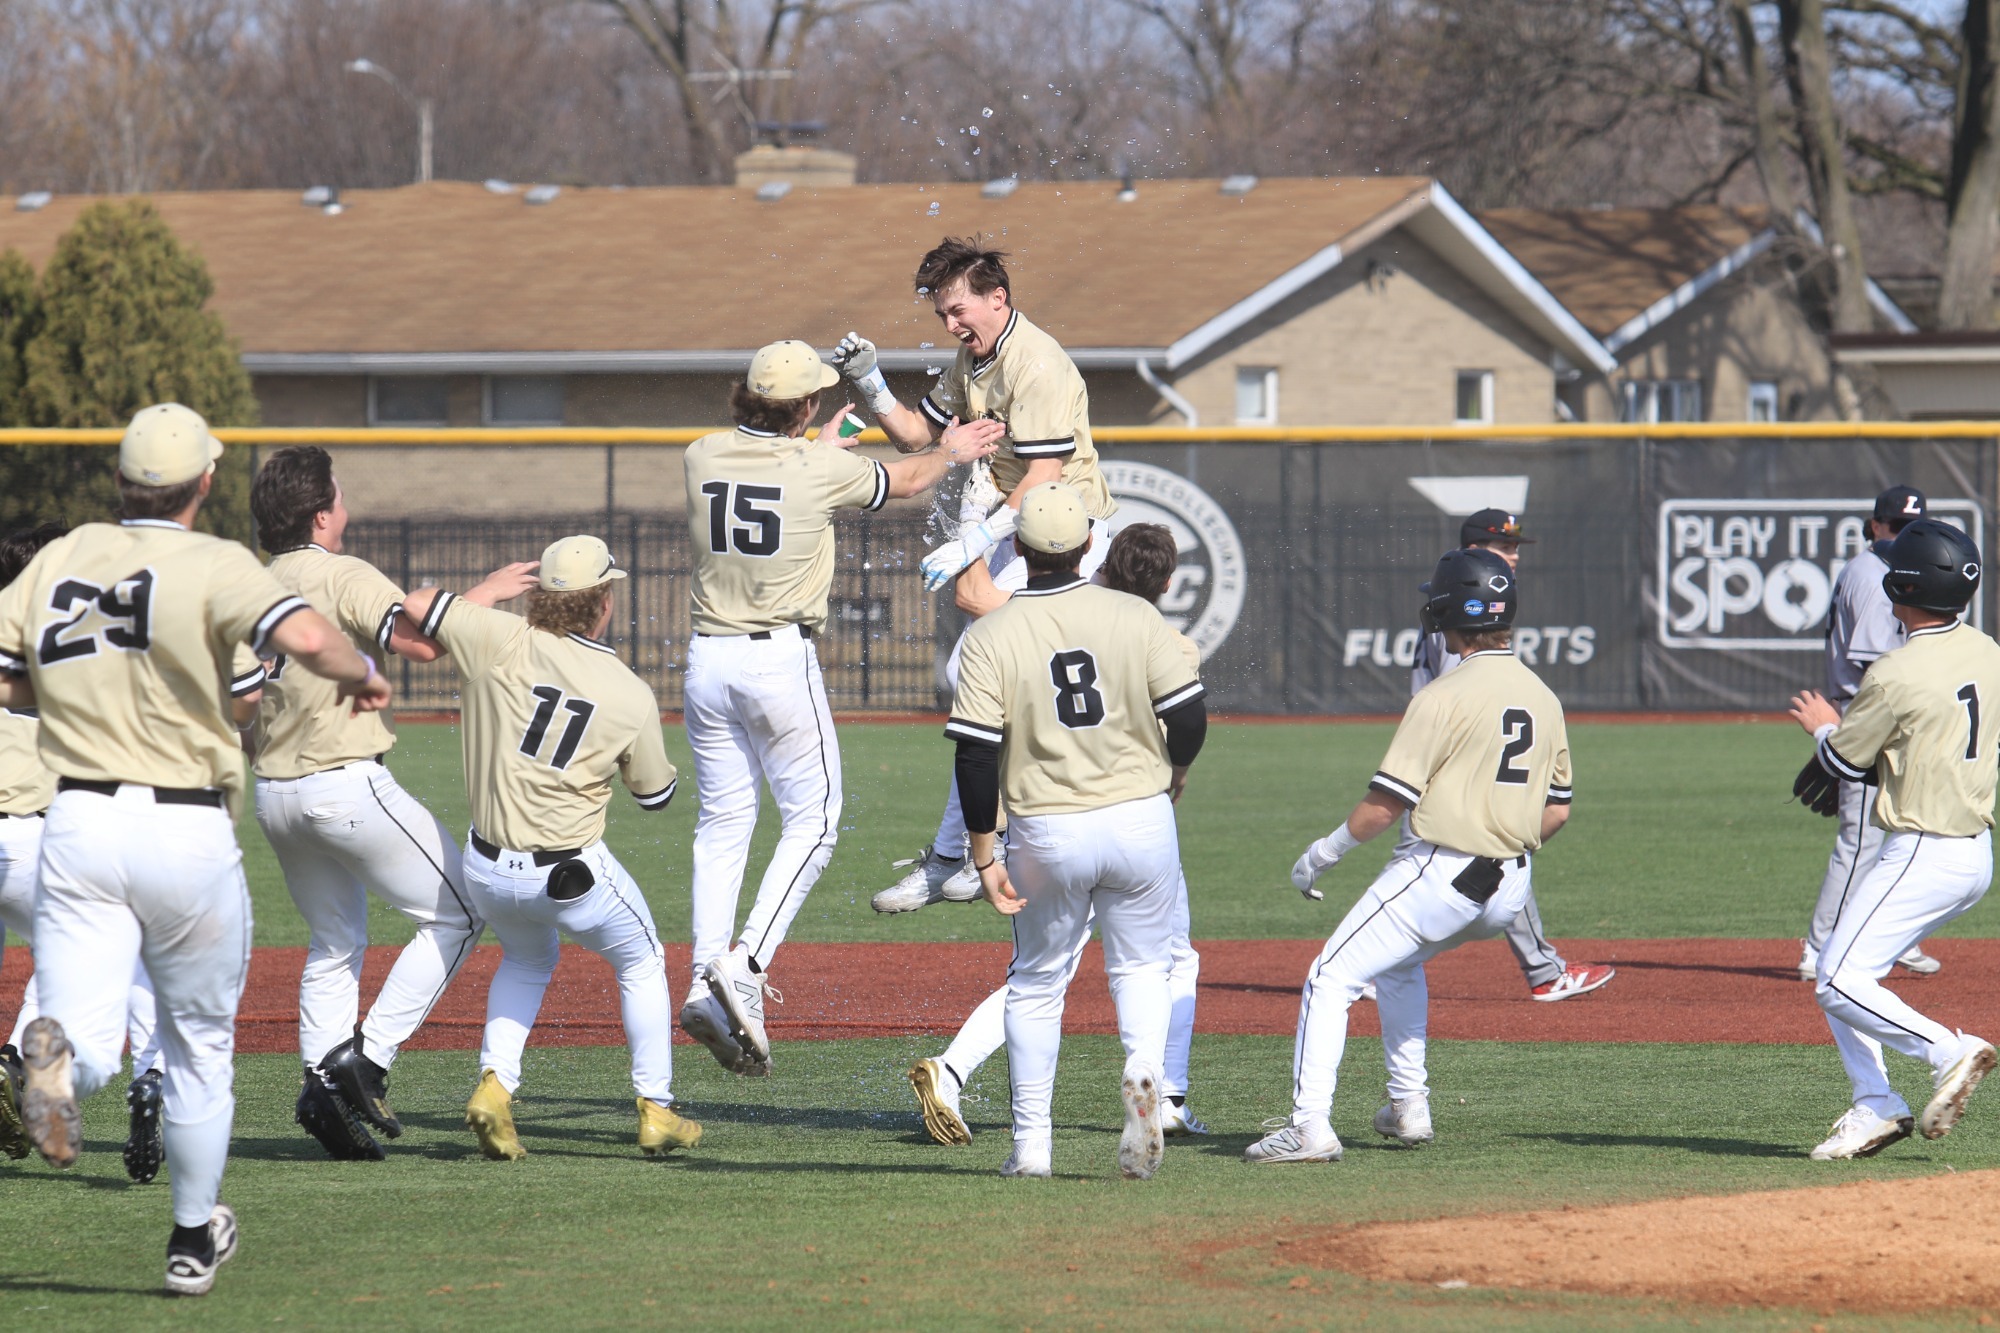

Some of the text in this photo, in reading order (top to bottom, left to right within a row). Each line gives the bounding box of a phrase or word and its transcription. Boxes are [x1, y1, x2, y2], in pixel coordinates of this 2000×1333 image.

[701, 479, 785, 558] 15
[1105, 467, 1238, 592] NTERCOLLEGIATE
[1674, 516, 1776, 557] PLAY
[1789, 516, 1828, 557] IT
[1903, 495, 1921, 515] L
[37, 565, 157, 668] 29
[1343, 625, 1597, 668] FLORTS
[517, 684, 596, 771] 11
[1049, 647, 1106, 730] 8
[1957, 681, 1981, 762] 1
[1495, 706, 1536, 787] 2
